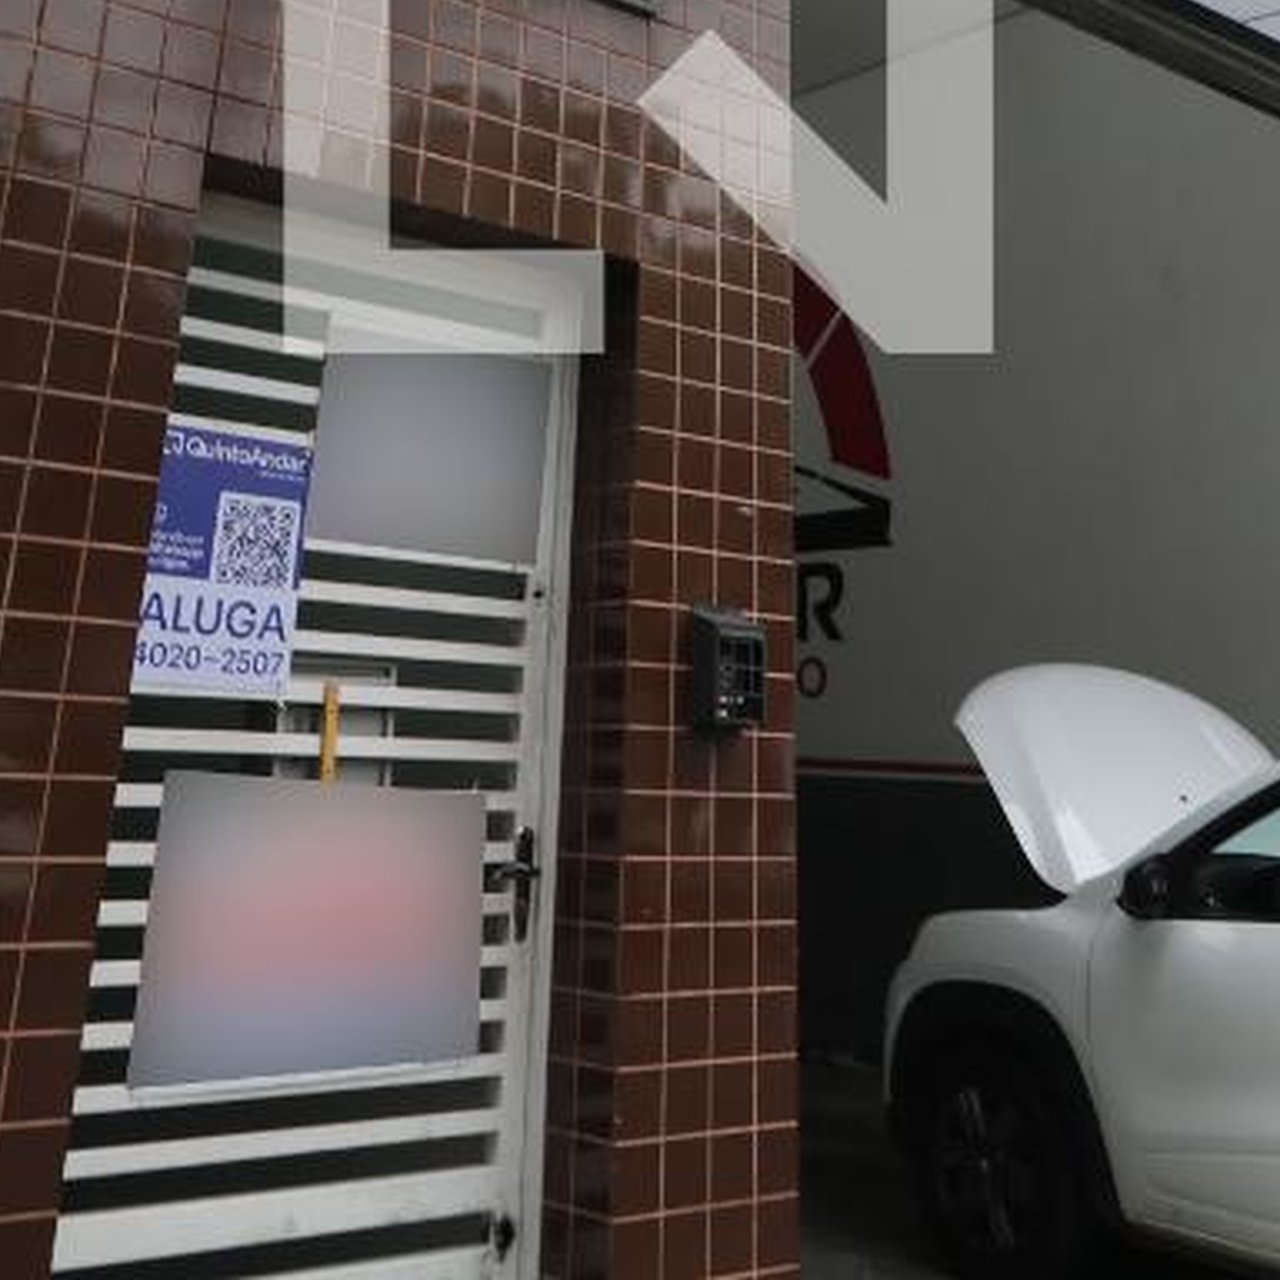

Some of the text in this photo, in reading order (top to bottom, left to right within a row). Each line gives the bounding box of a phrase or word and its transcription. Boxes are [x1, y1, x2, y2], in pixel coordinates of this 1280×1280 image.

[185, 434, 308, 472] QuintoAndar
[141, 591, 286, 643] ALUGA
[135, 641, 285, 677] 4020-2507
